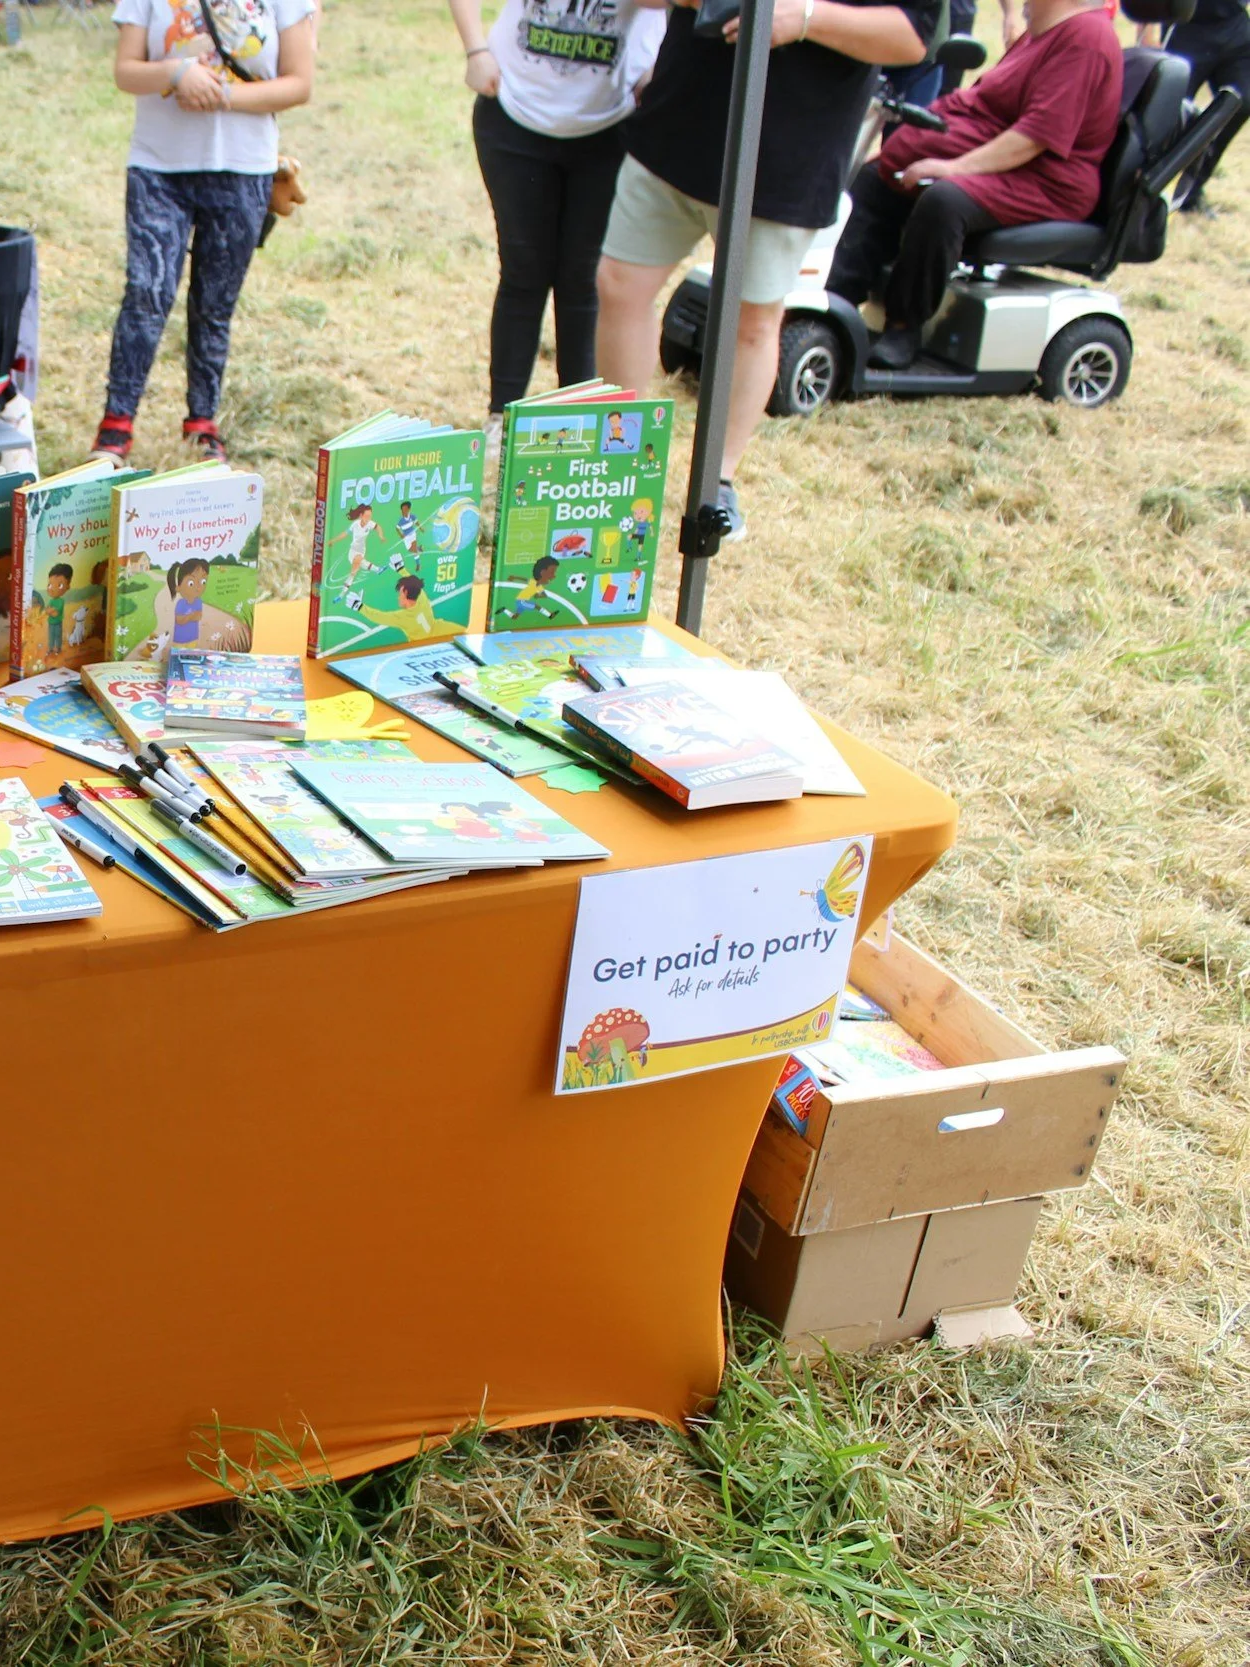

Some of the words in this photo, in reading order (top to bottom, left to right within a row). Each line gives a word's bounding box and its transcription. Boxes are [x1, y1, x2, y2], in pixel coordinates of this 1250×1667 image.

[374, 458, 402, 473] LOOK
[406, 451, 442, 468] INSIDE
[568, 459, 609, 477] First
[340, 464, 473, 509] FOOTBALL
[536, 475, 637, 500] Football
[162, 509, 174, 517] First
[176, 506, 201, 515] Questions
[213, 503, 235, 511] Answers
[555, 500, 612, 521] Book
[47, 522, 75, 540] Why
[80, 517, 109, 533] shou
[134, 524, 160, 540] Why
[163, 520, 177, 534] do
[181, 520, 185, 532] I
[188, 512, 247, 532] (sometimes)
[313, 499, 326, 566] FOOTBALL
[57, 541, 79, 557] say
[157, 536, 180, 552] feel
[185, 529, 234, 552] angry?
[437, 555, 457, 564] over
[13, 568, 22, 584] Why
[436, 564, 457, 582] 50
[13, 585, 21, 608] should
[434, 581, 456, 593] flaps
[188, 665, 286, 680] STAYING
[192, 679, 266, 690] ONLINE
[592, 955, 647, 982] Get
[654, 939, 720, 981] paid
[727, 940, 755, 961] to
[762, 927, 838, 963] party
[667, 977, 693, 999] Ask
[695, 979, 714, 999] for
[717, 965, 759, 992] details
[759, 1028, 793, 1046] partnership
[774, 1034, 808, 1048] USBORNE
[786, 1092, 809, 1120] PIECES
